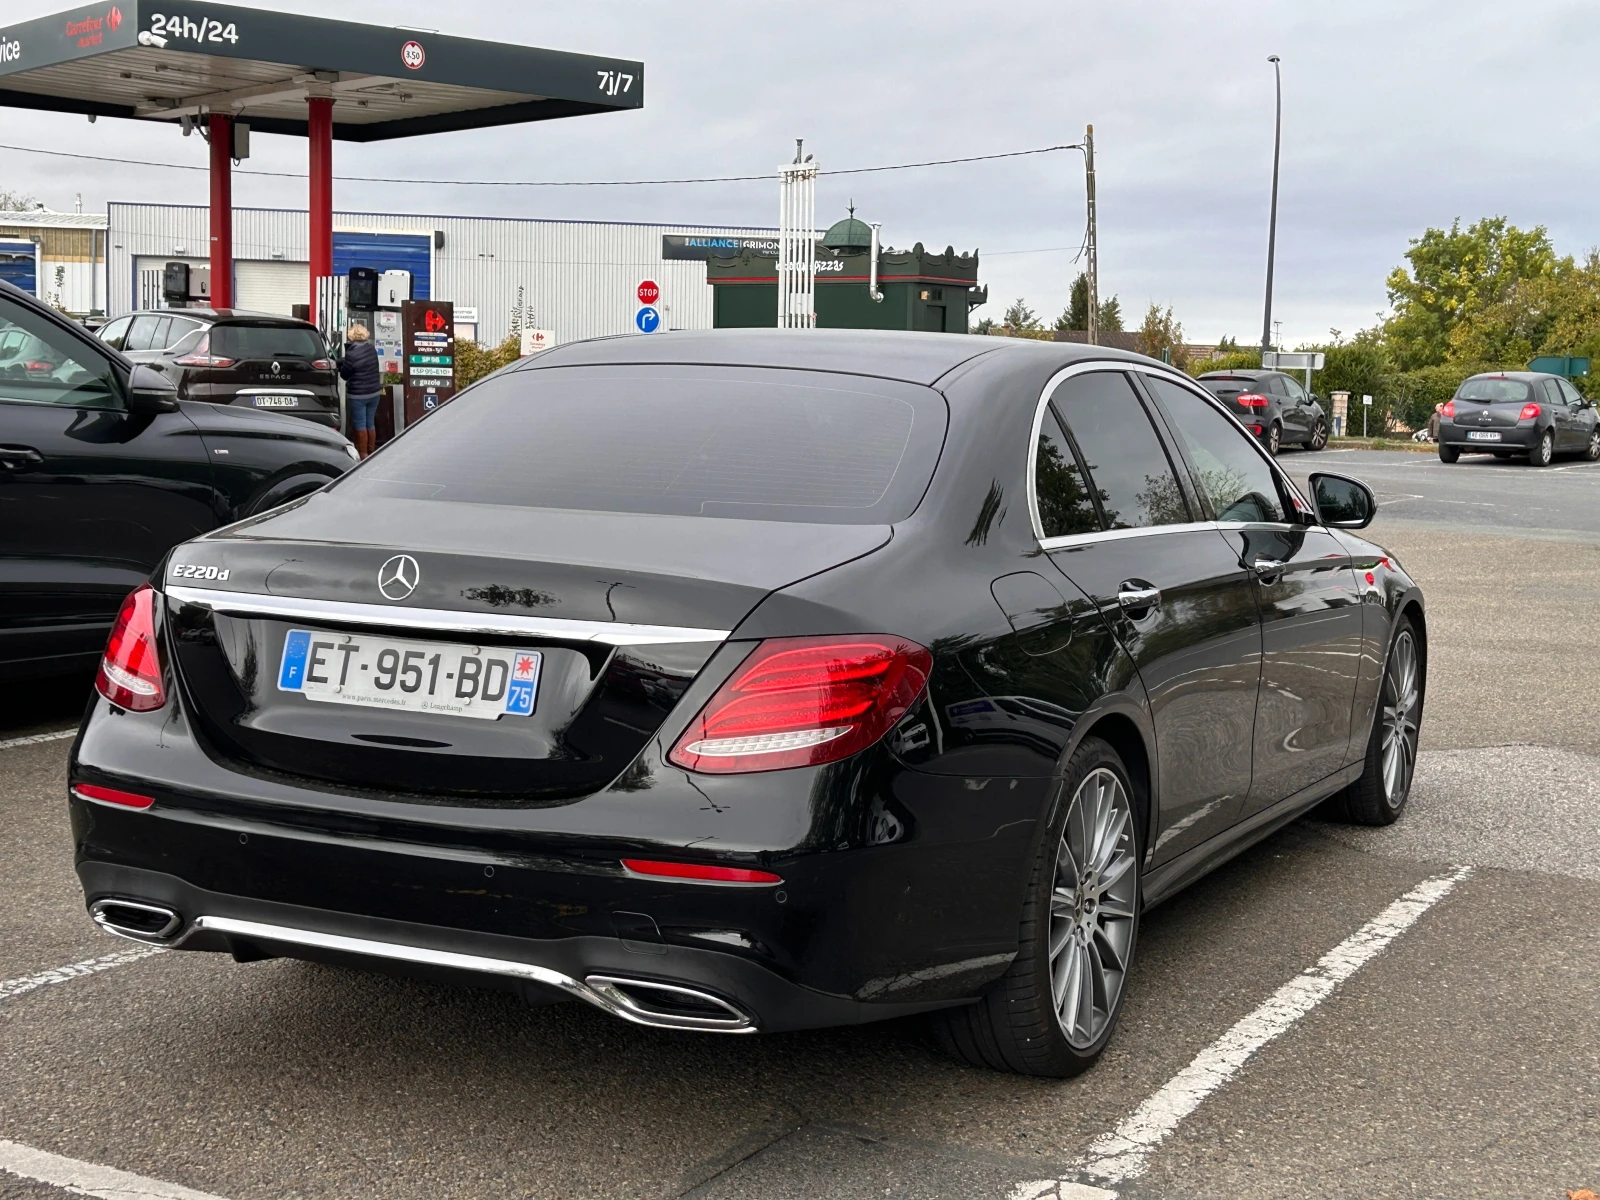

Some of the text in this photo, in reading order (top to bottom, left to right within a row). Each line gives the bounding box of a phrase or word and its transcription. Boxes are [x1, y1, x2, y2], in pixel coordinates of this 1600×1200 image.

[150, 13, 239, 45] 24h/24
[405, 50, 421, 61] 3.50
[597, 70, 634, 96] 7j/7
[689, 238, 739, 248] ALLIANCE
[639, 288, 658, 297] STOP
[421, 355, 430, 363] SP
[172, 564, 230, 581] E220d
[288, 666, 298, 679] F
[306, 641, 510, 702] ET-951-BD
[508, 686, 532, 708] 75
